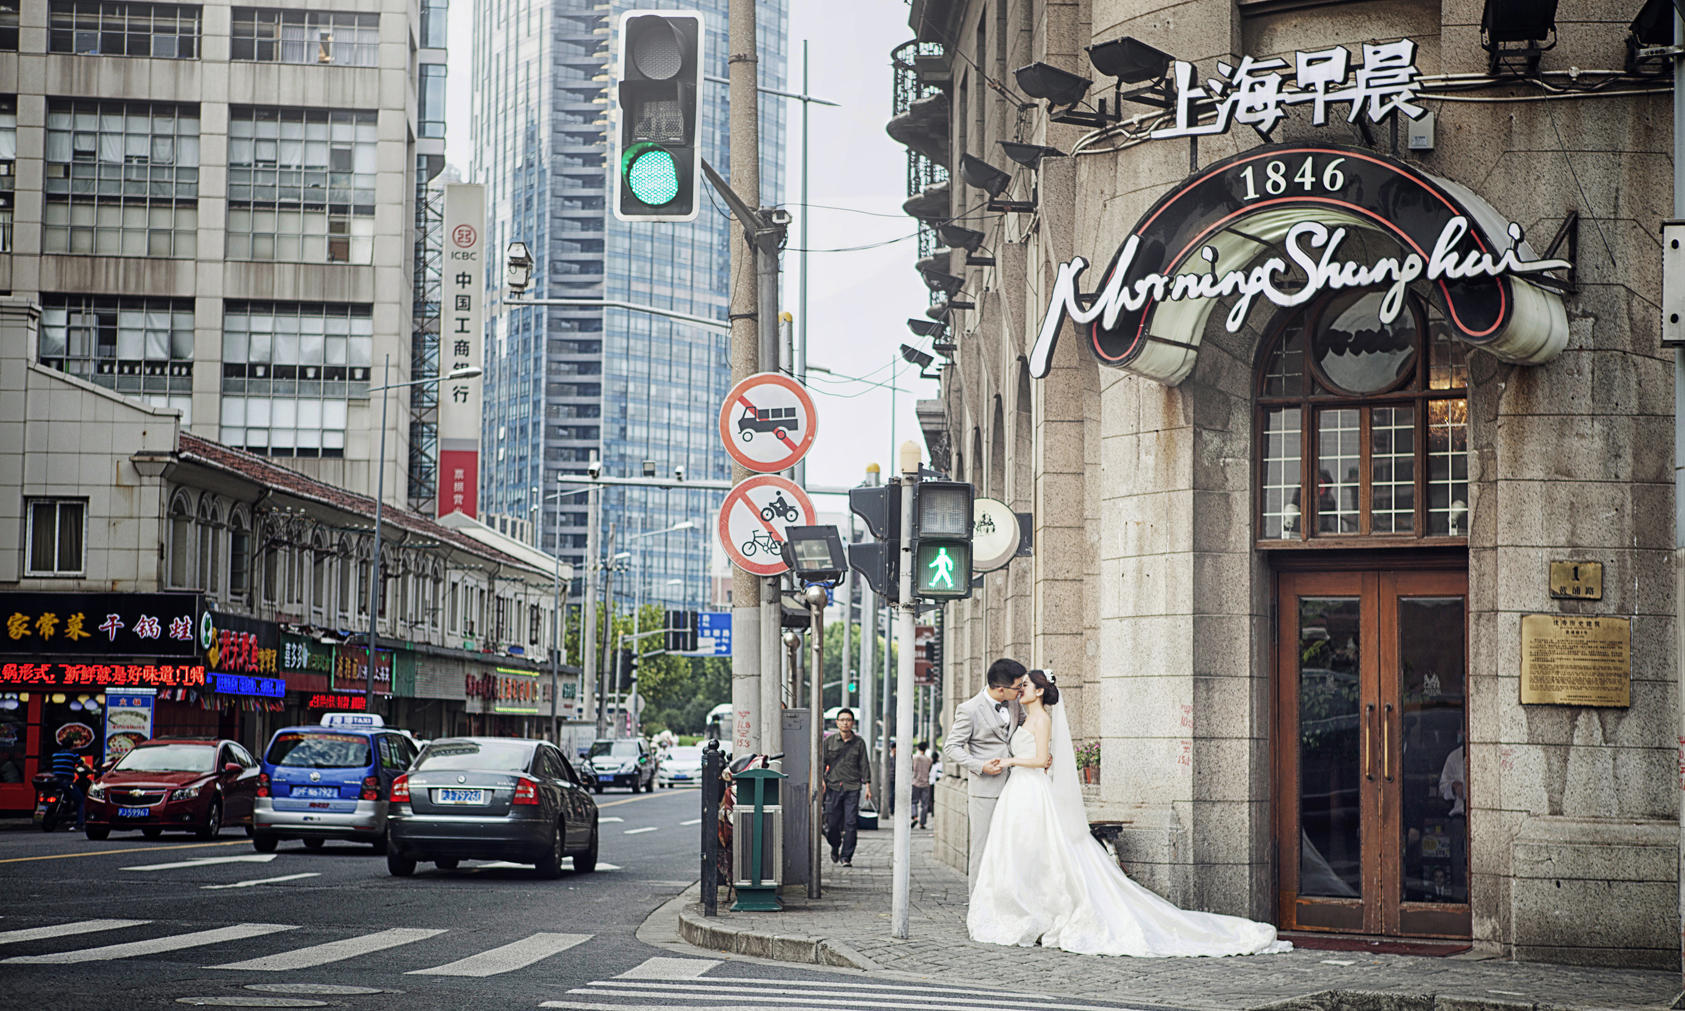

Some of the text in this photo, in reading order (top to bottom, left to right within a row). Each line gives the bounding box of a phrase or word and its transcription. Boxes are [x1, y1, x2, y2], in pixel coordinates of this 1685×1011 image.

[1150, 37, 1427, 139] 上海早晨
[1240, 156, 1346, 201] 1846
[451, 251, 477, 261] ICBC
[1266, 215, 1572, 325] Shanghai
[1572, 566, 1580, 581] 1
[6, 612, 194, 641] 家常菜 干锅蛙
